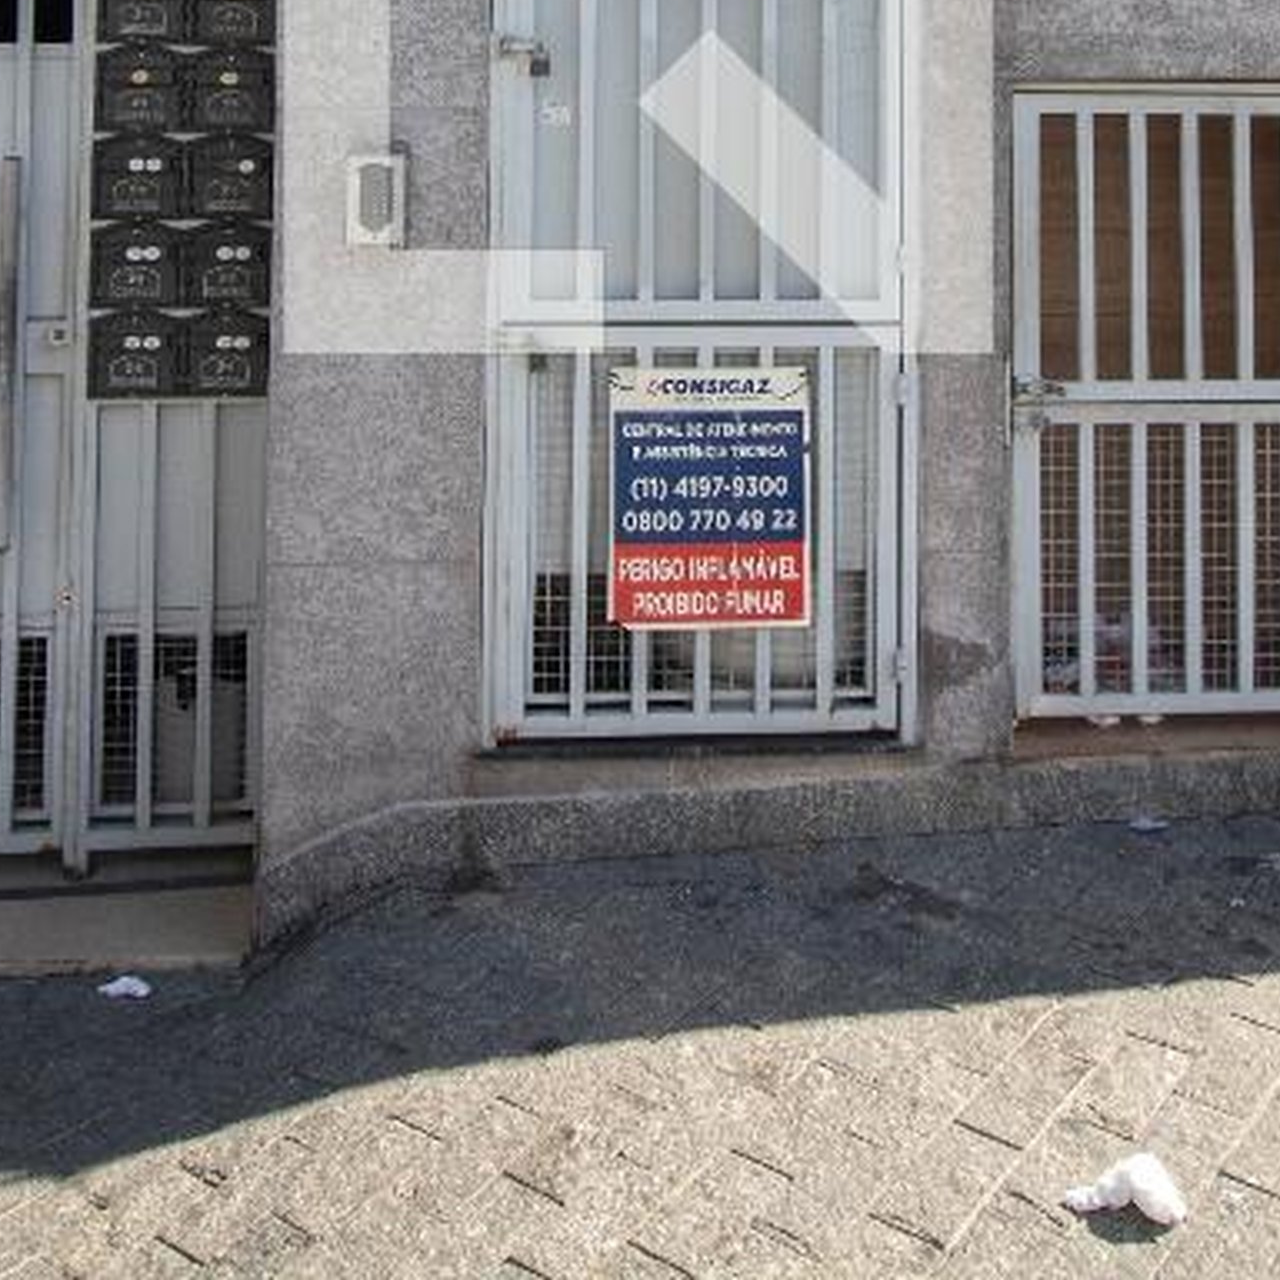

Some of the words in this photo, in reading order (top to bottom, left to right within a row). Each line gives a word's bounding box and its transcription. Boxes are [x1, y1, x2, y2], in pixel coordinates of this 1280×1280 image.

[661, 378, 771, 395] CONSIGAZ
[630, 476, 668, 501] (11)
[672, 475, 789, 498] 4197-9300
[622, 509, 684, 532] 0800
[688, 509, 731, 531] 770
[771, 508, 798, 531] 22
